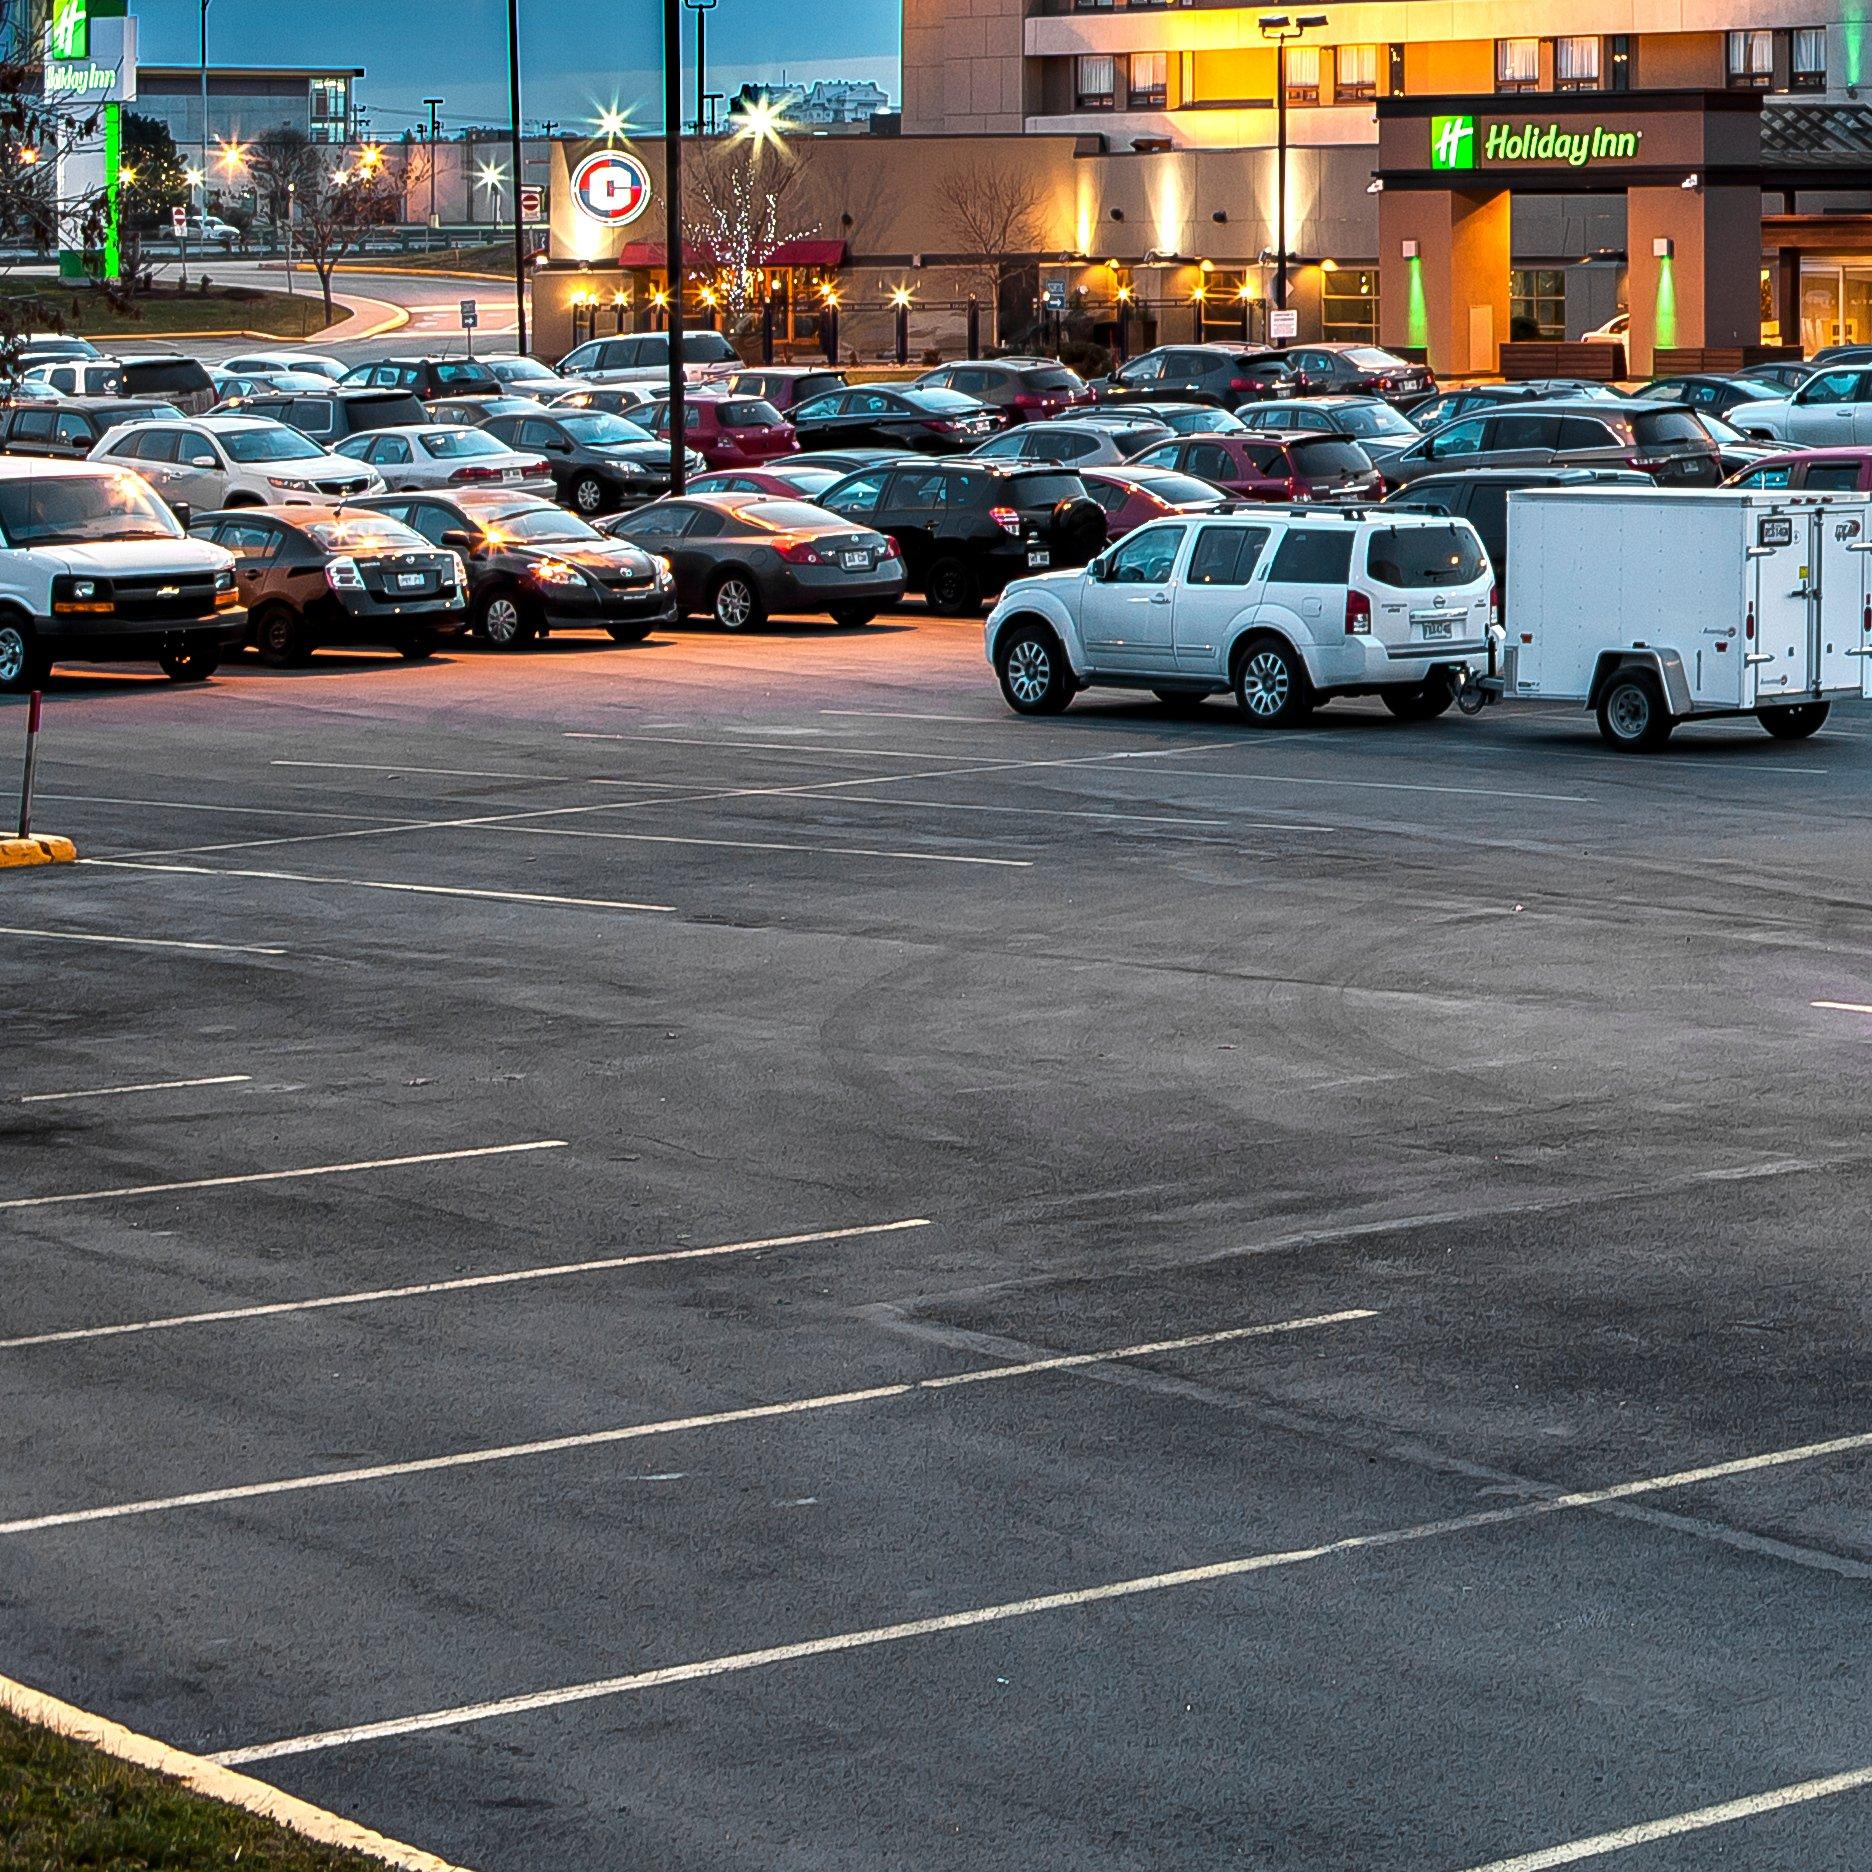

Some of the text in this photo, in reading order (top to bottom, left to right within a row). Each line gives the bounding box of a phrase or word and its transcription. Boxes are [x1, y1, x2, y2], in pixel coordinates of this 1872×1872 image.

[45, 62, 116, 95] Holiday Inn
[1485, 124, 1636, 166] Holiday Inn
